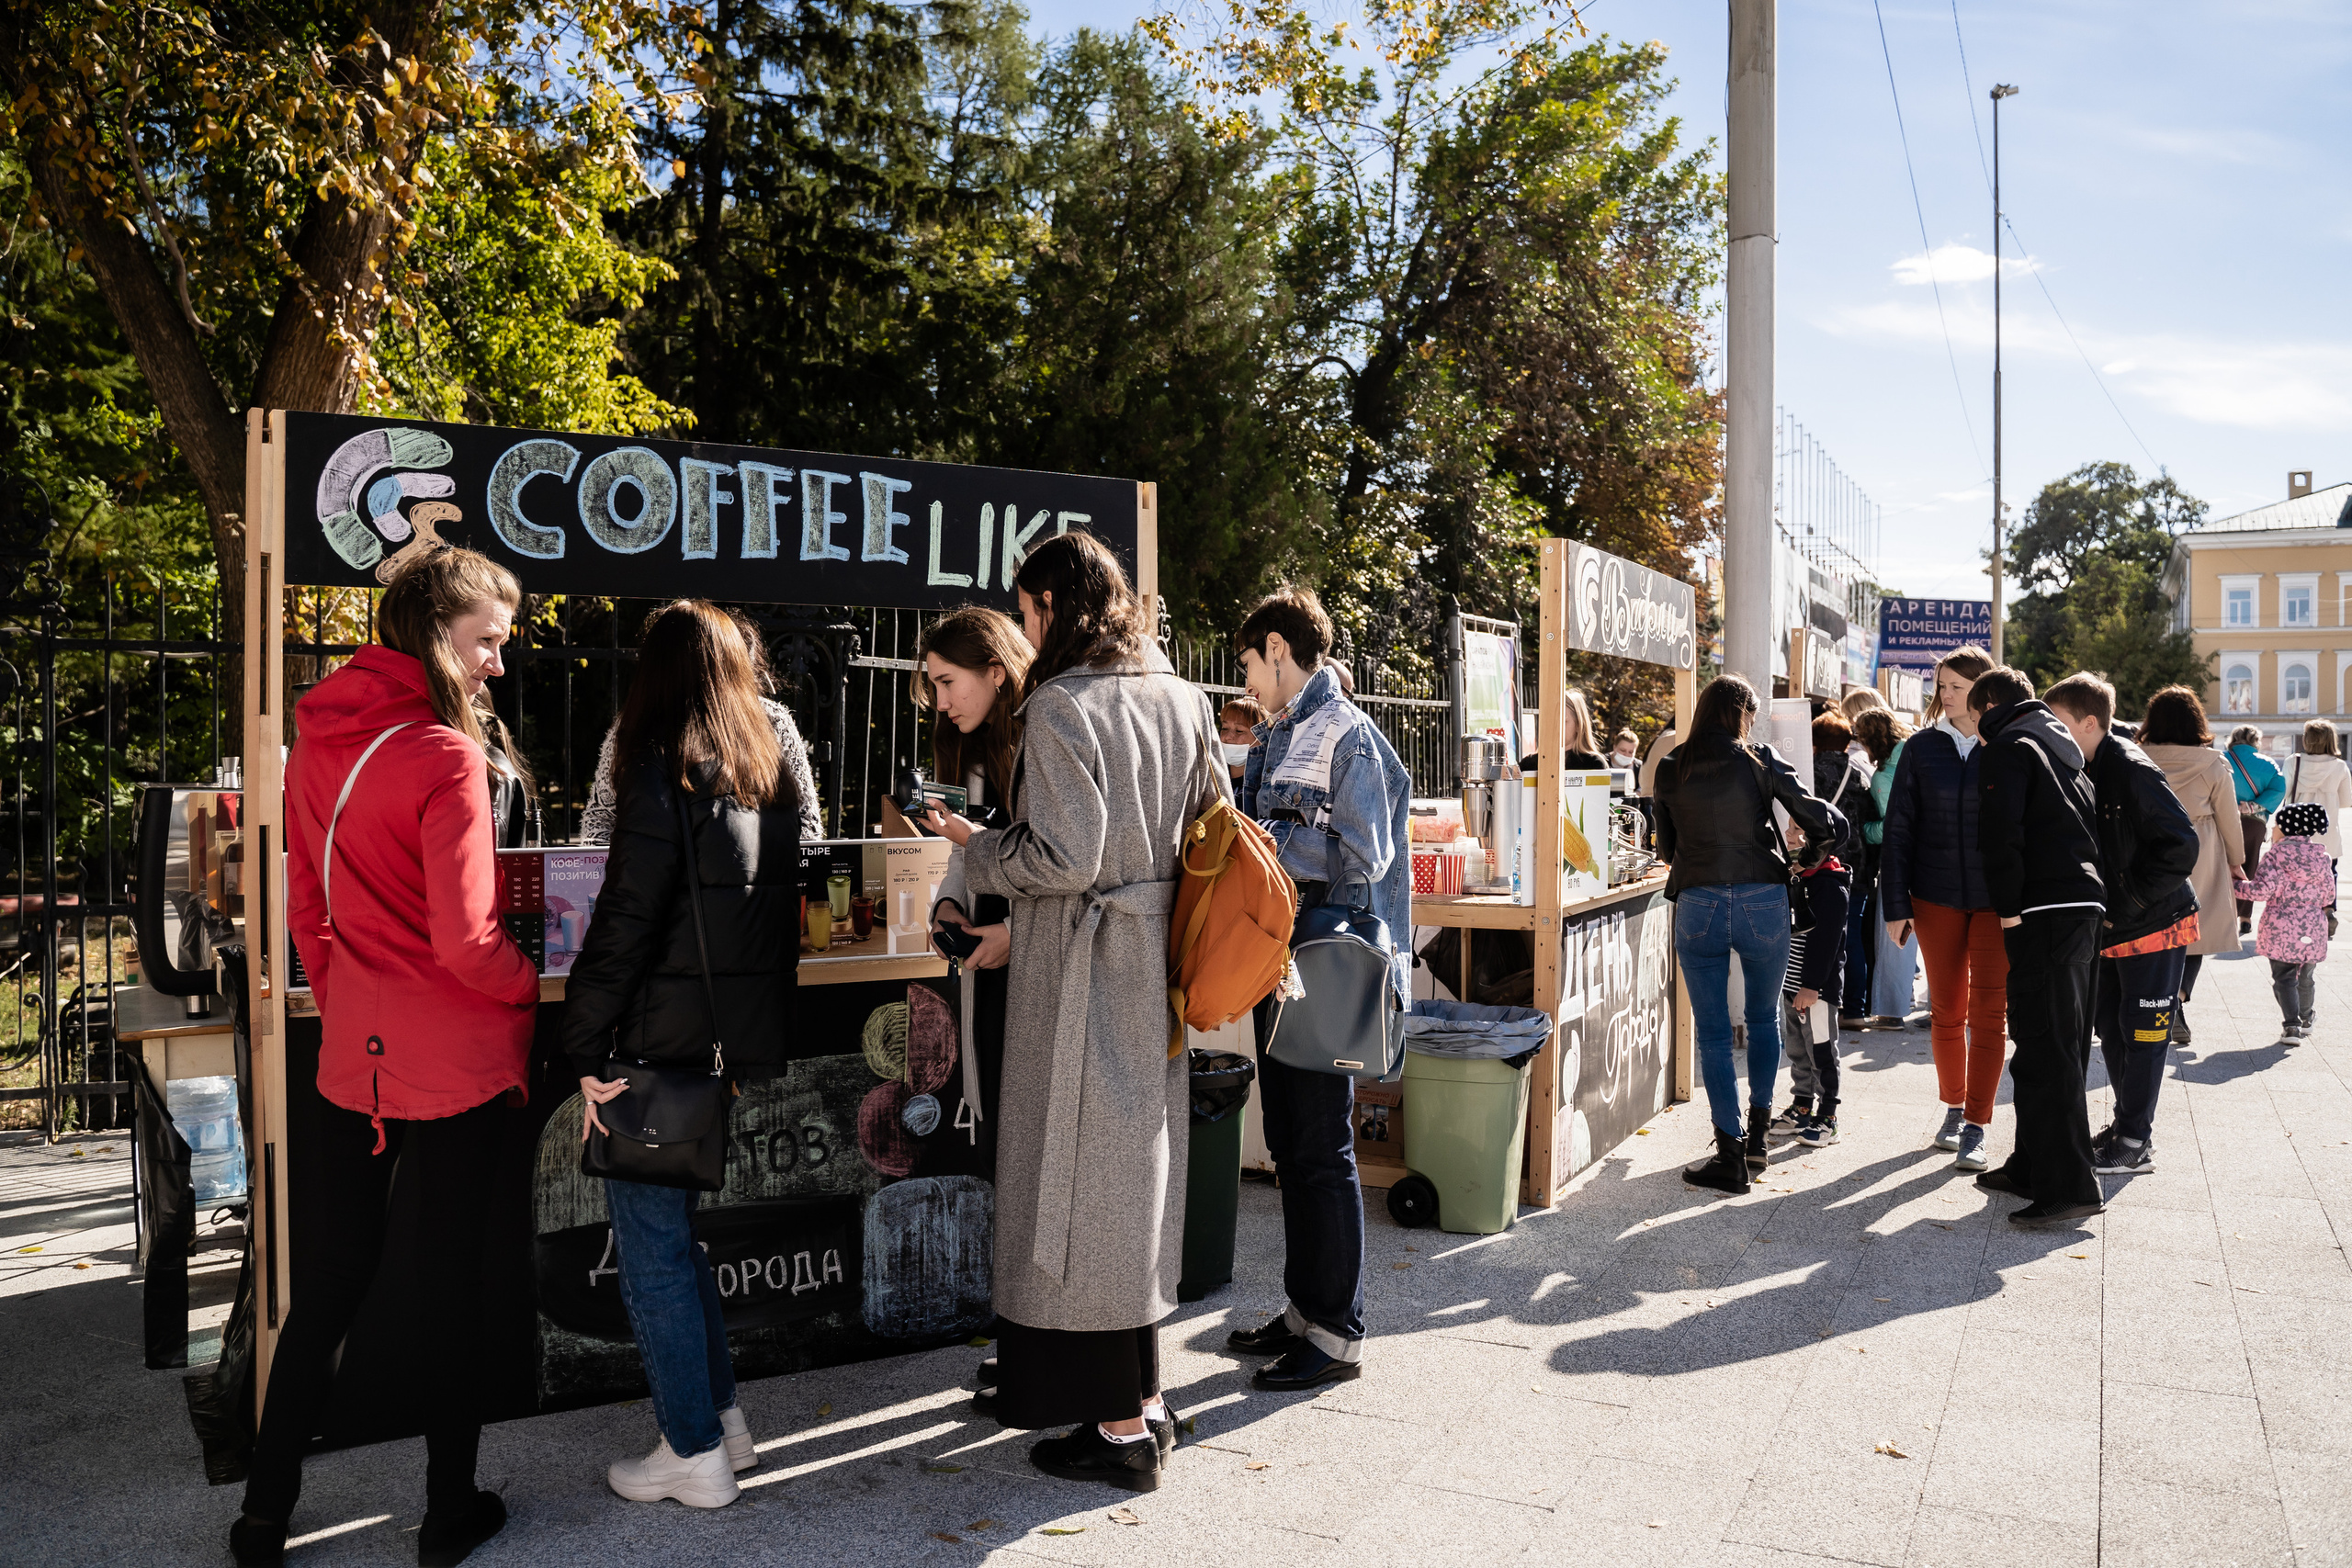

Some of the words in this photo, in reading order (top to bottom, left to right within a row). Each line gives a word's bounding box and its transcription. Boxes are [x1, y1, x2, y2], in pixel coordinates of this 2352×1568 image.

[487, 439, 912, 563] COFFEE
[1889, 600, 1991, 619] АРЕНДА
[1888, 619, 1992, 635] ПОМЕЩЕНИЙ
[1899, 637, 1962, 646] РЕКЛАМНЫХ
[551, 871, 600, 881] ПОЗИТИВ
[1559, 911, 1633, 1042] ДЕНЬ
[1354, 1089, 1390, 1099] СТОРОЖНО
[1357, 1095, 1386, 1104] БРОСАТЬ
[710, 1248, 843, 1297] ОРОДА
